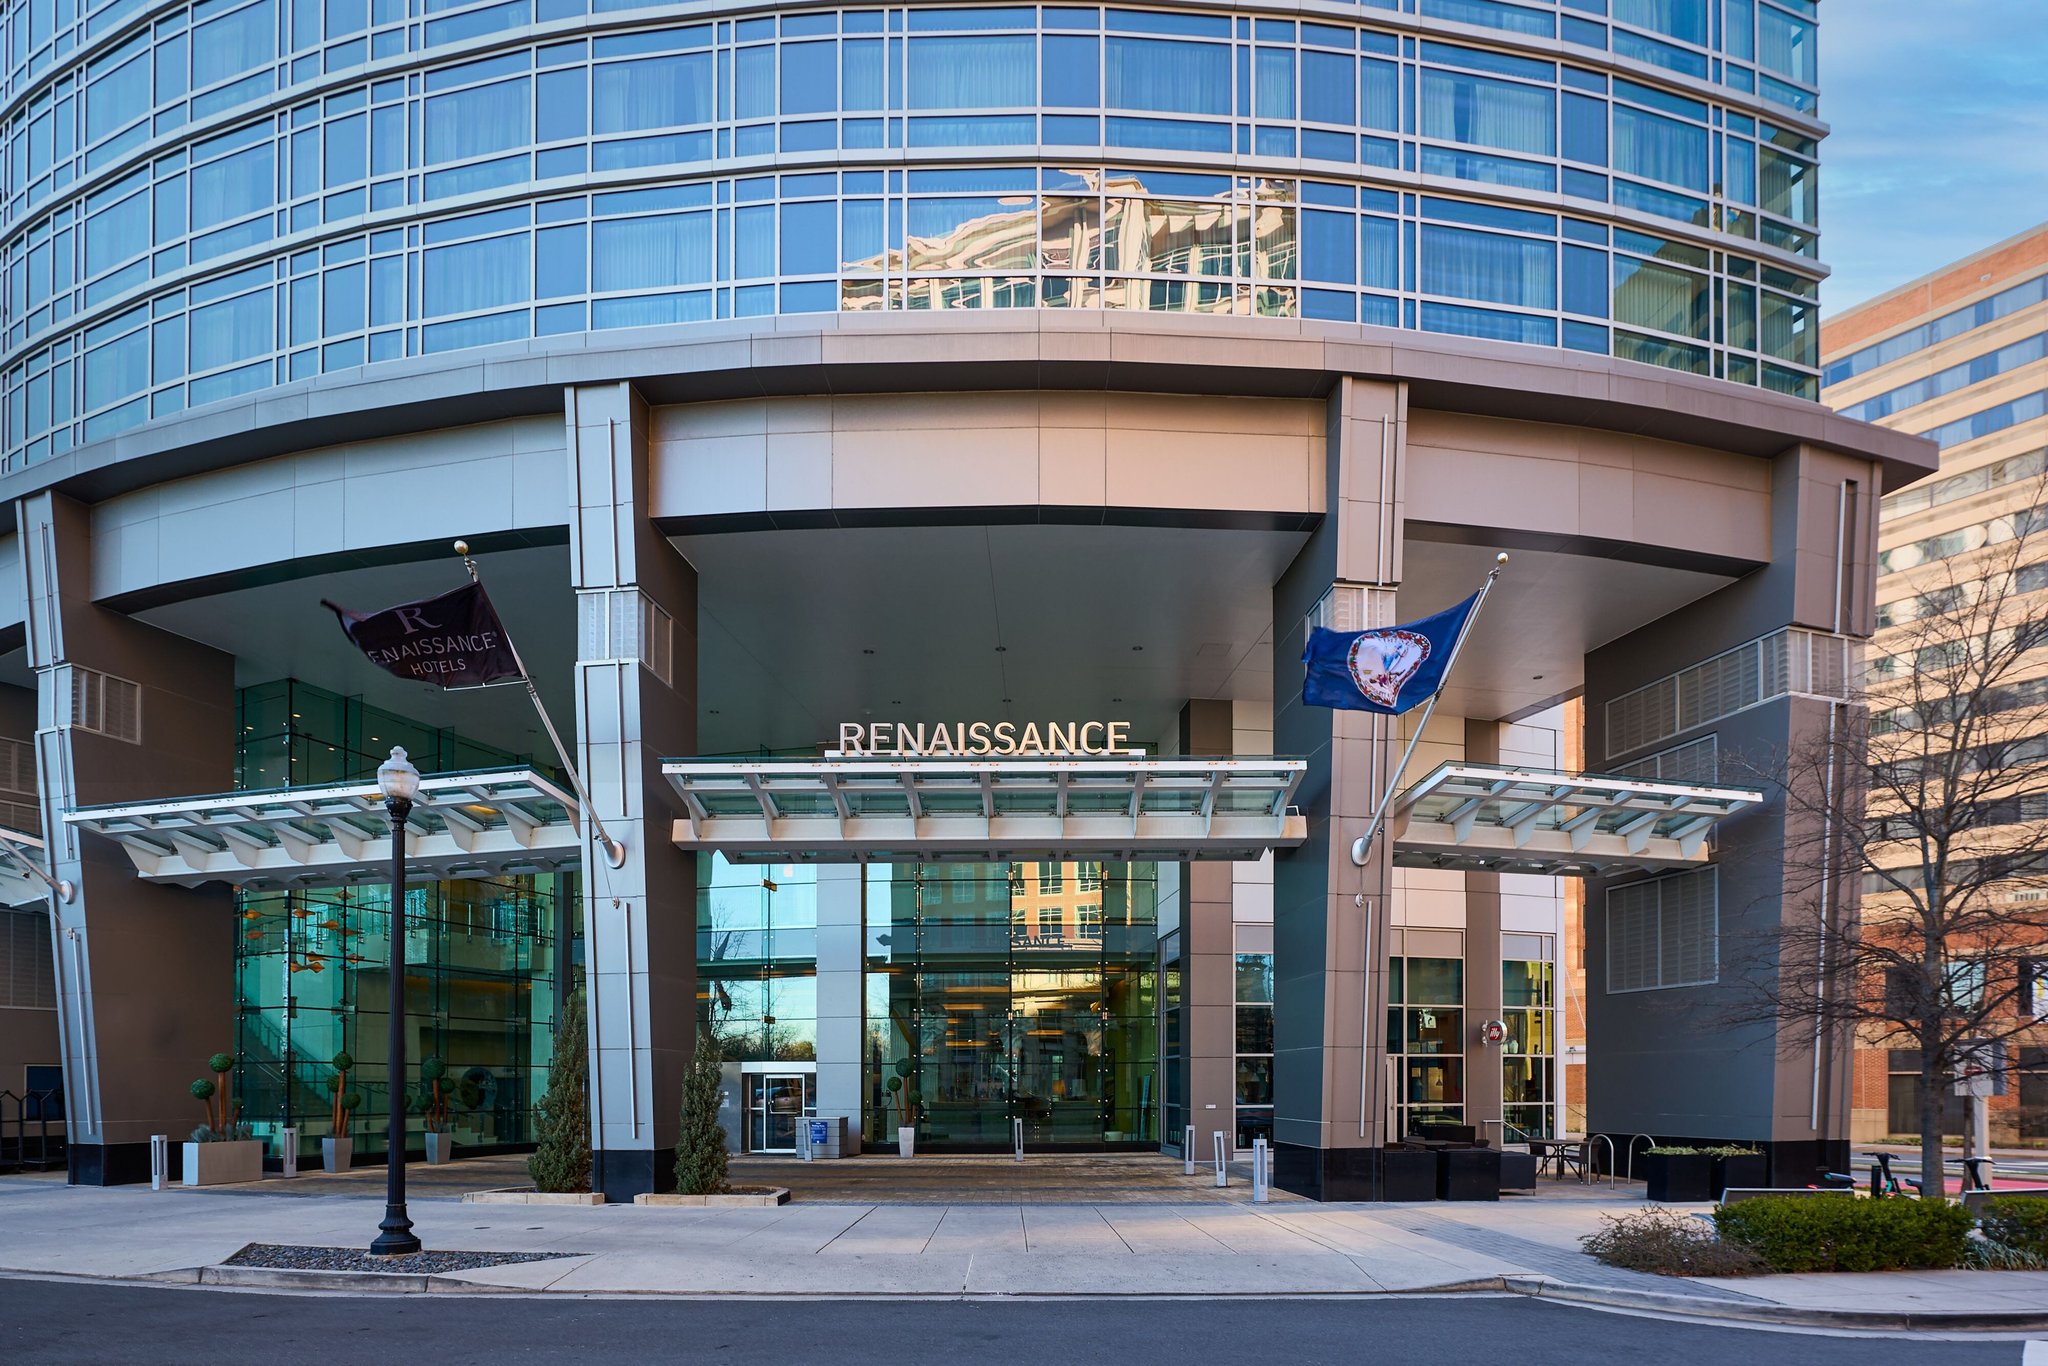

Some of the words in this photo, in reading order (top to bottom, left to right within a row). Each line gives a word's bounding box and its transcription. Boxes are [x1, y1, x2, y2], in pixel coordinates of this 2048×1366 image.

[393, 607, 442, 635] R
[367, 632, 496, 663] ENAISSANCE
[410, 658, 466, 675] HOTELS
[839, 721, 1131, 755] RENAISSANCE
